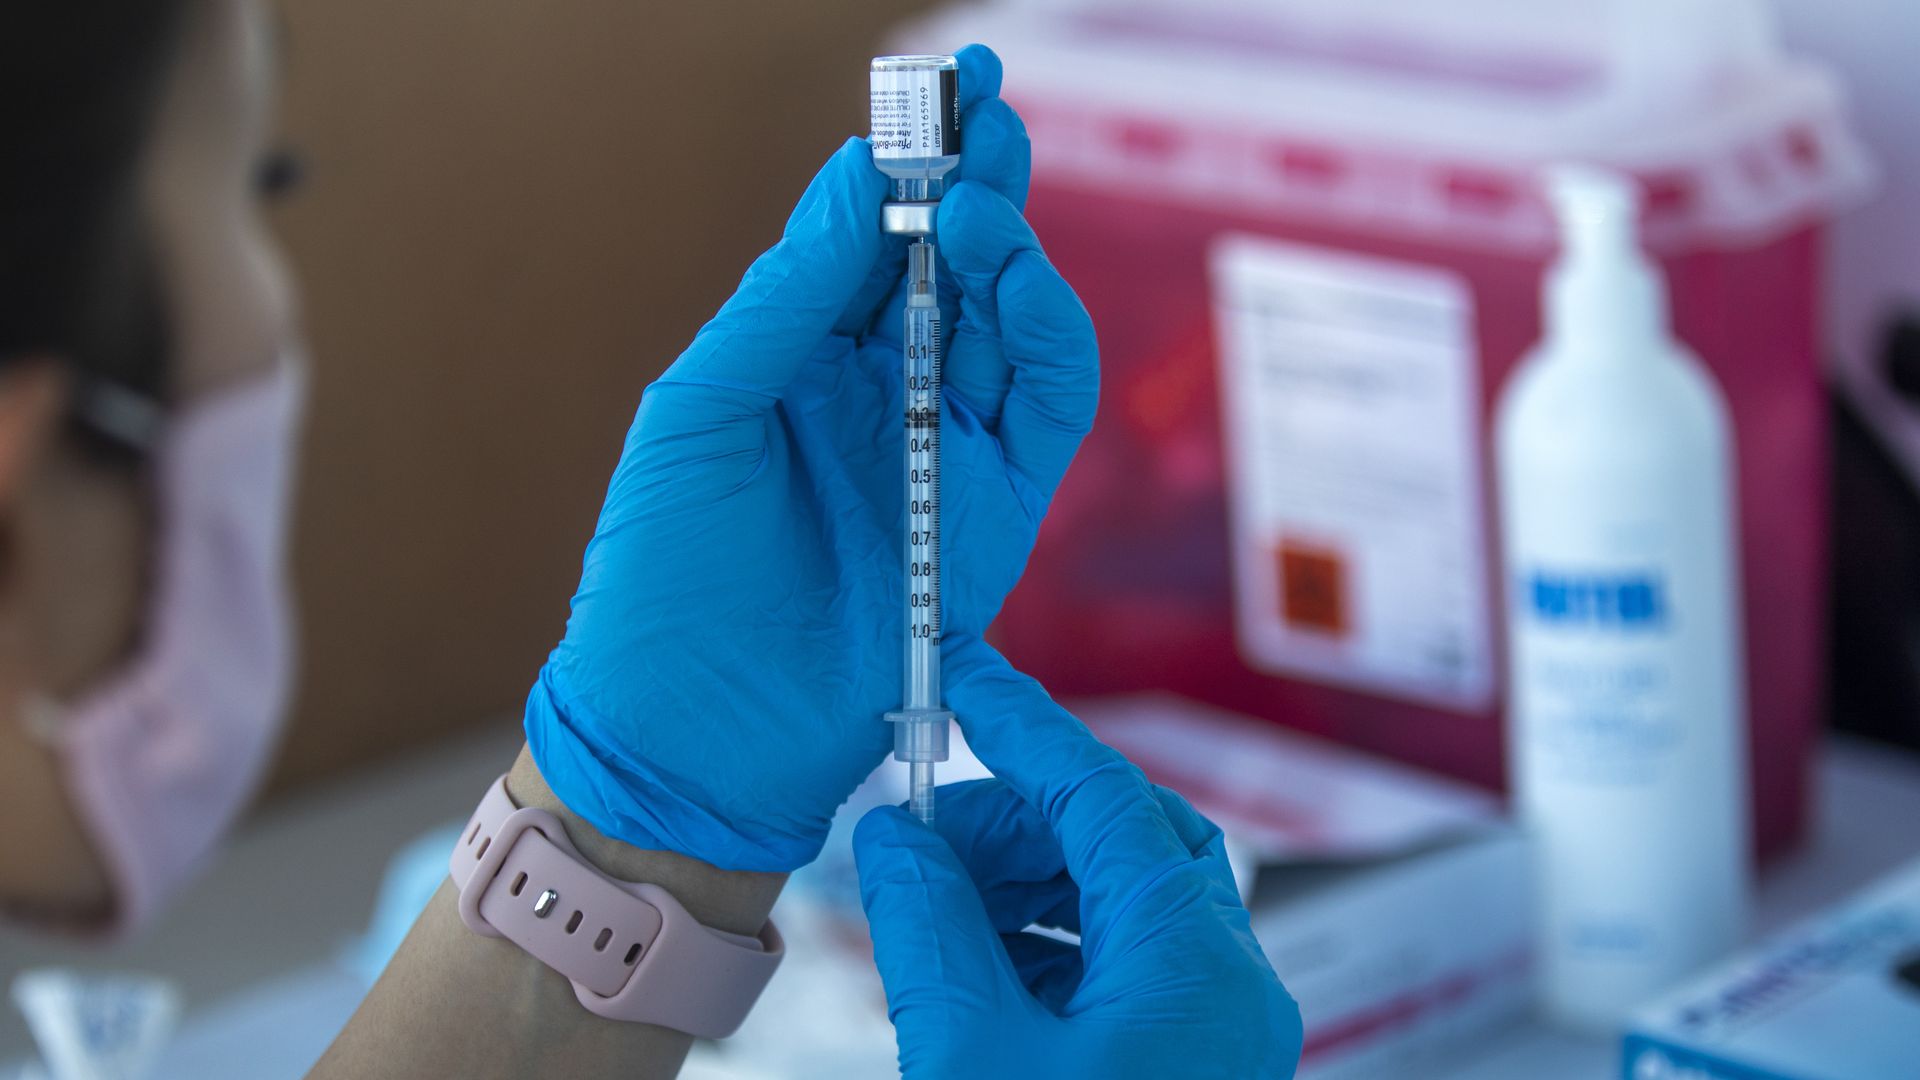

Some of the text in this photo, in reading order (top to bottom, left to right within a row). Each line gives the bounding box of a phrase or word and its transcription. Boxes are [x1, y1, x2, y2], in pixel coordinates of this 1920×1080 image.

[920, 86, 930, 148] PAA165969
[873, 138, 912, 150] Pfizer-BioN
[908, 345, 928, 360] 0.1
[909, 376, 929, 391] 0.2
[910, 407, 930, 422] 0.3
[910, 438, 931, 453] 0.4
[911, 469, 931, 484] 0.5
[911, 500, 931, 515] 0.6
[911, 531, 931, 546] 0.7
[911, 562, 931, 577] 0.8
[911, 592, 931, 608] 0.9
[911, 623, 931, 639] 1.0
